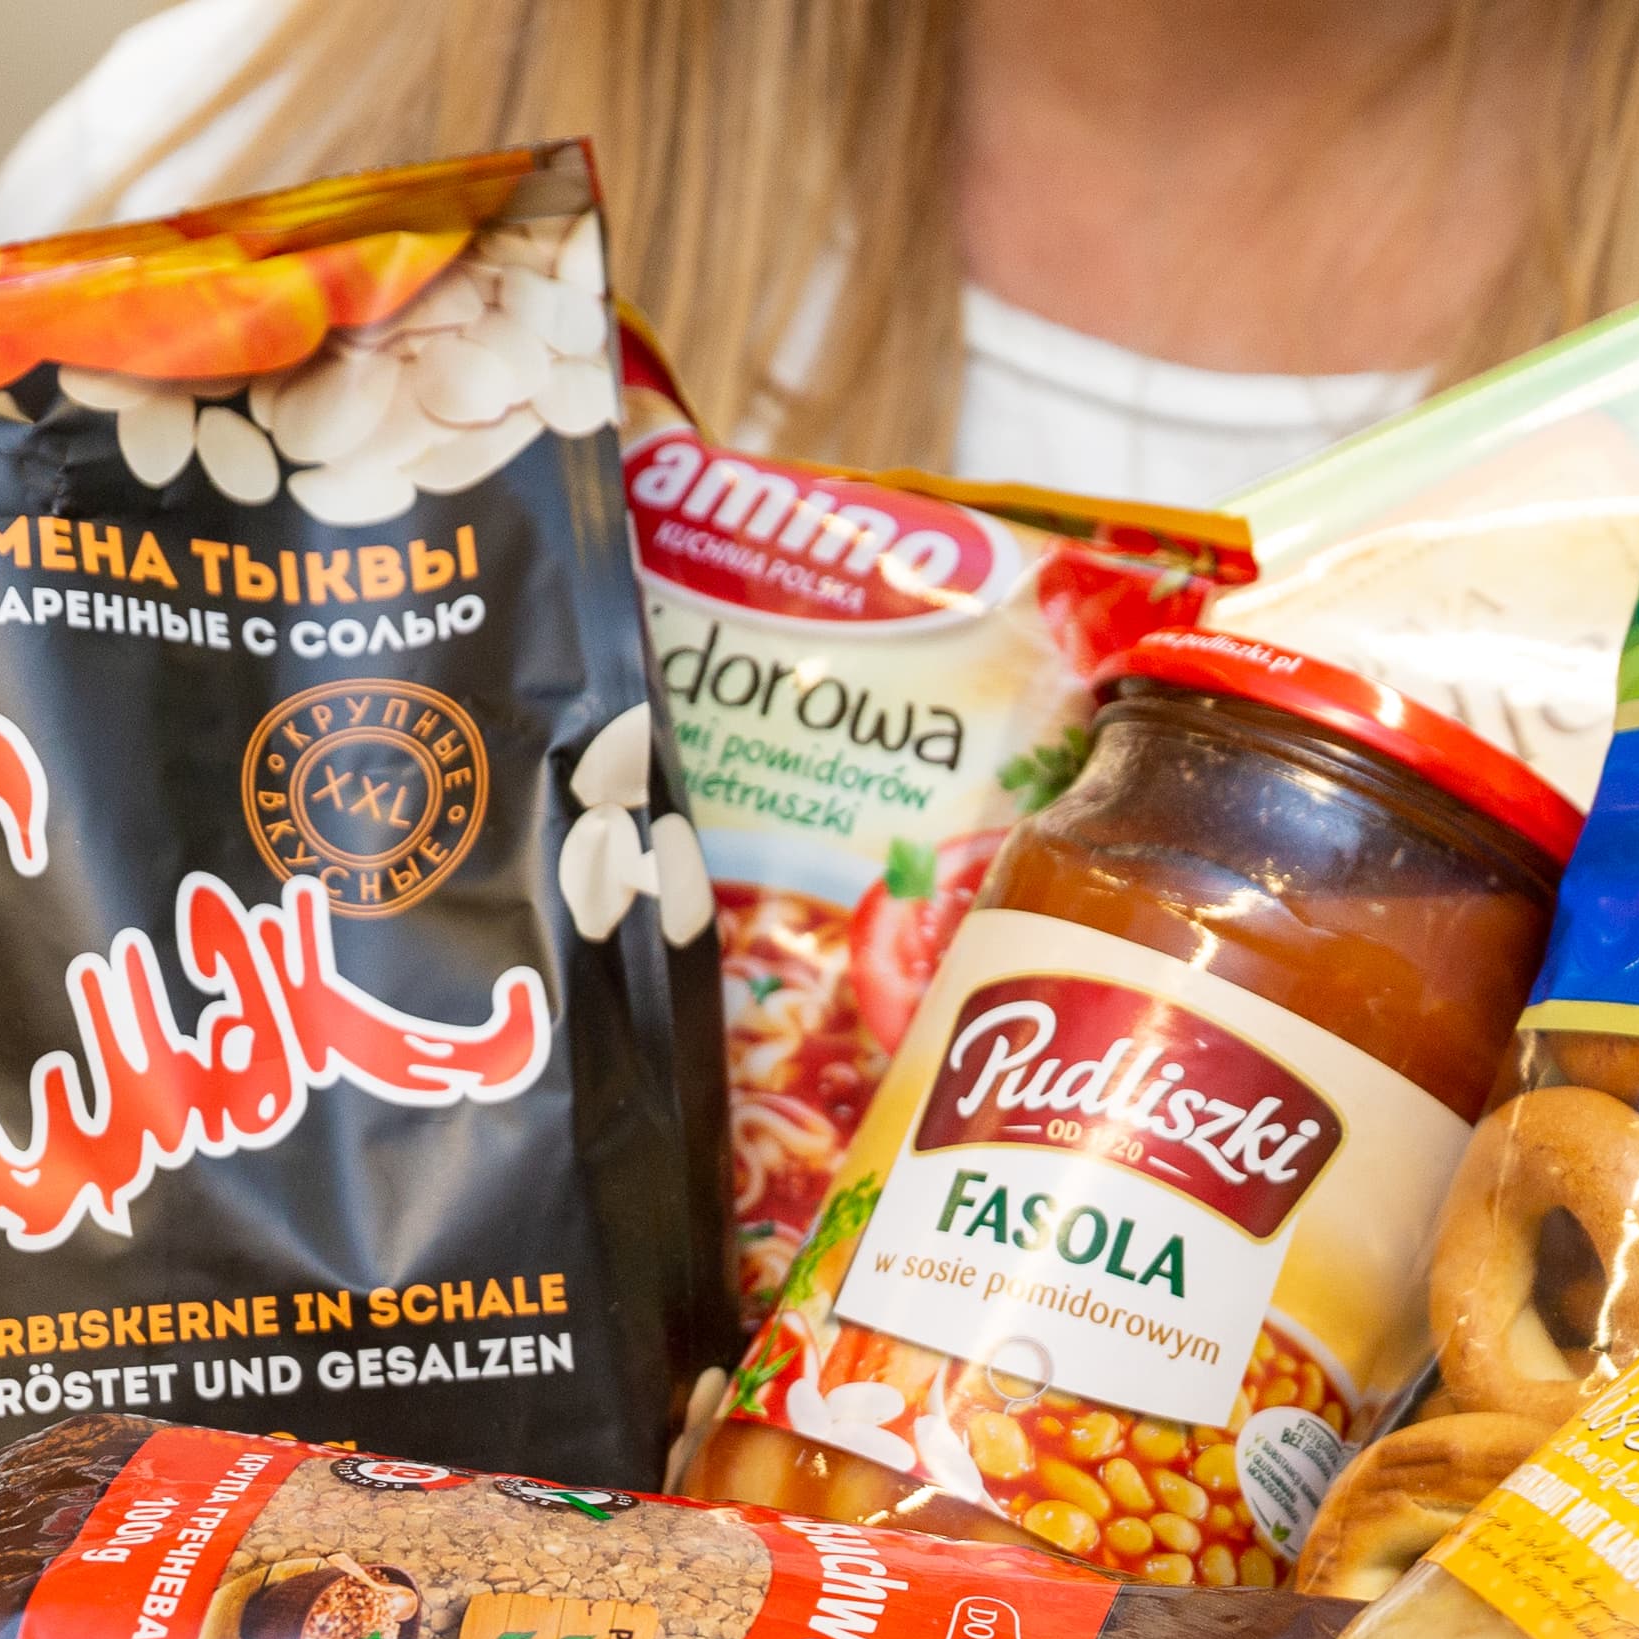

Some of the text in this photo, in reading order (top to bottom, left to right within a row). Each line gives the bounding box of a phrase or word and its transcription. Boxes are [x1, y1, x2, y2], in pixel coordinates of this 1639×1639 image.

[632, 443, 961, 591] amino
[652, 519, 765, 574] KUCHNIA
[191, 526, 480, 606] ТЫКВЫ
[242, 616, 279, 657] С
[290, 593, 487, 660] СОЛЬЮ
[662, 620, 965, 772] dorowa
[281, 695, 473, 791] КРУПНЫЕ
[311, 764, 412, 829] XXL
[257, 790, 450, 903] ВКУСНЫЕ
[949, 1000, 1321, 1186] Pudliszki
[1046, 1118, 1083, 1143] OD
[936, 1168, 1189, 1300] FASOLA
[294, 1289, 352, 1333] IN
[366, 1273, 569, 1328] SCHALE
[873, 1250, 1223, 1367] w sosie pomidorowym
[193, 1354, 303, 1400] UND
[315, 1332, 574, 1391] GESALZEN
[203, 1452, 274, 1504] КРУПА
[80, 1496, 180, 1564] 1000 g
[1559, 1497, 1611, 1541] MIT
